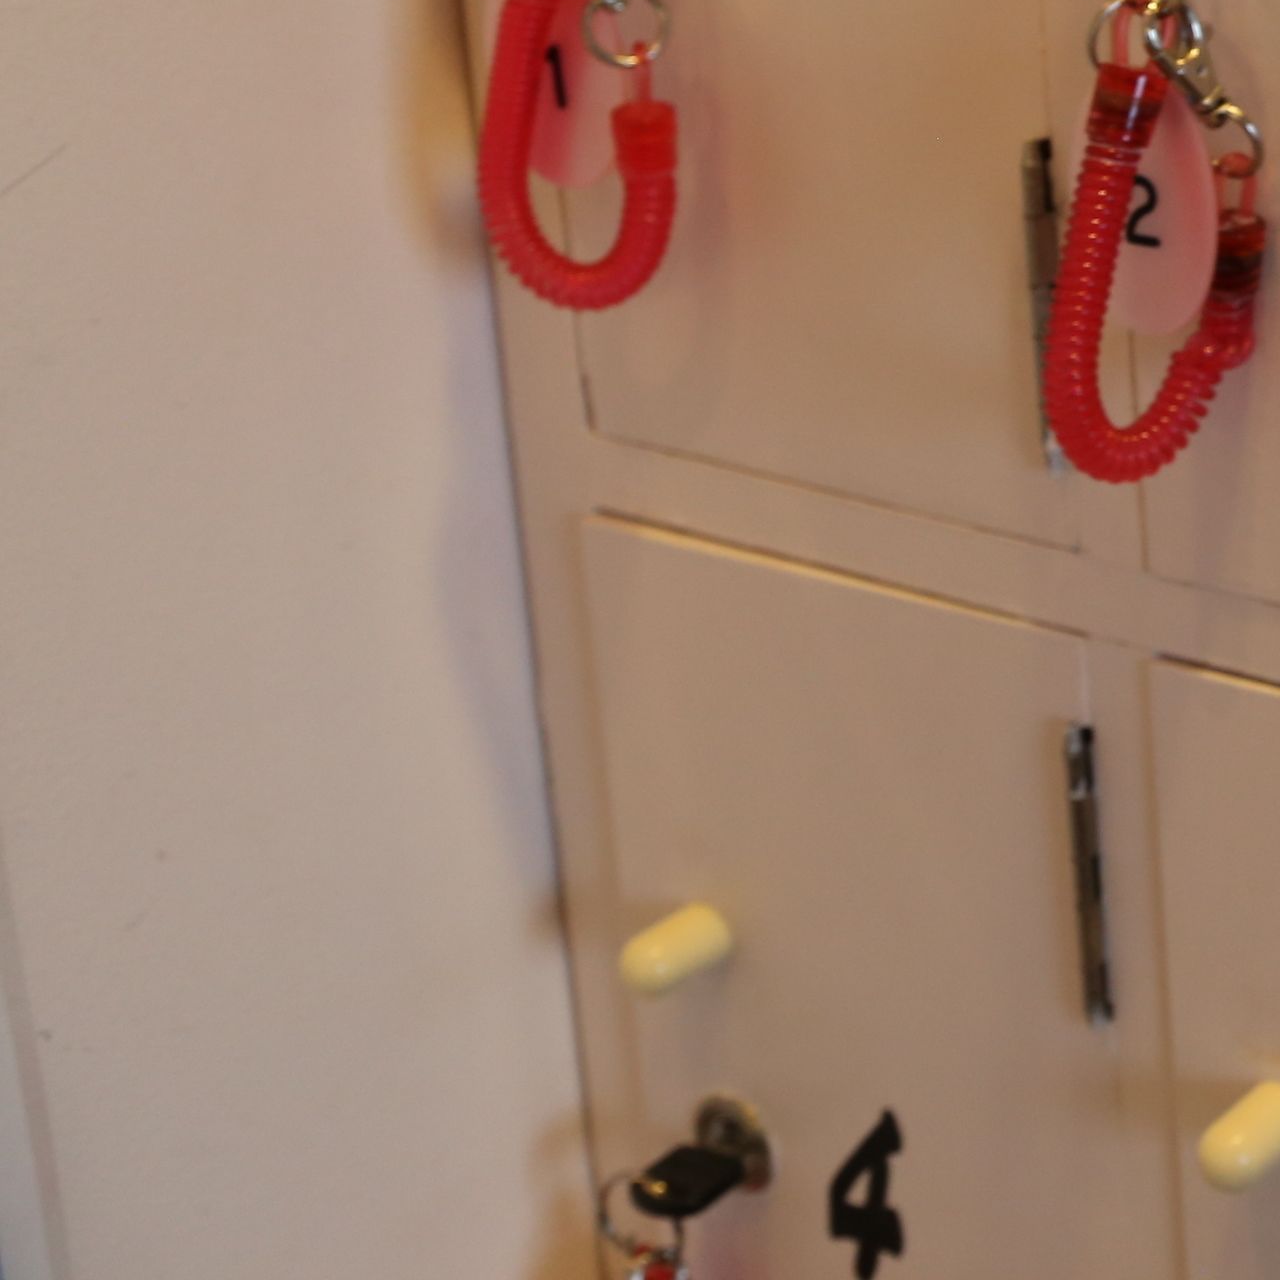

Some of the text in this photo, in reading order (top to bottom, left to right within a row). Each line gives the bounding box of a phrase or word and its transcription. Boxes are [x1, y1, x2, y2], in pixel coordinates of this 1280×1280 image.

[544, 44, 568, 109] 1
[1126, 175, 1162, 249] 2
[826, 1108, 906, 1280] 4
